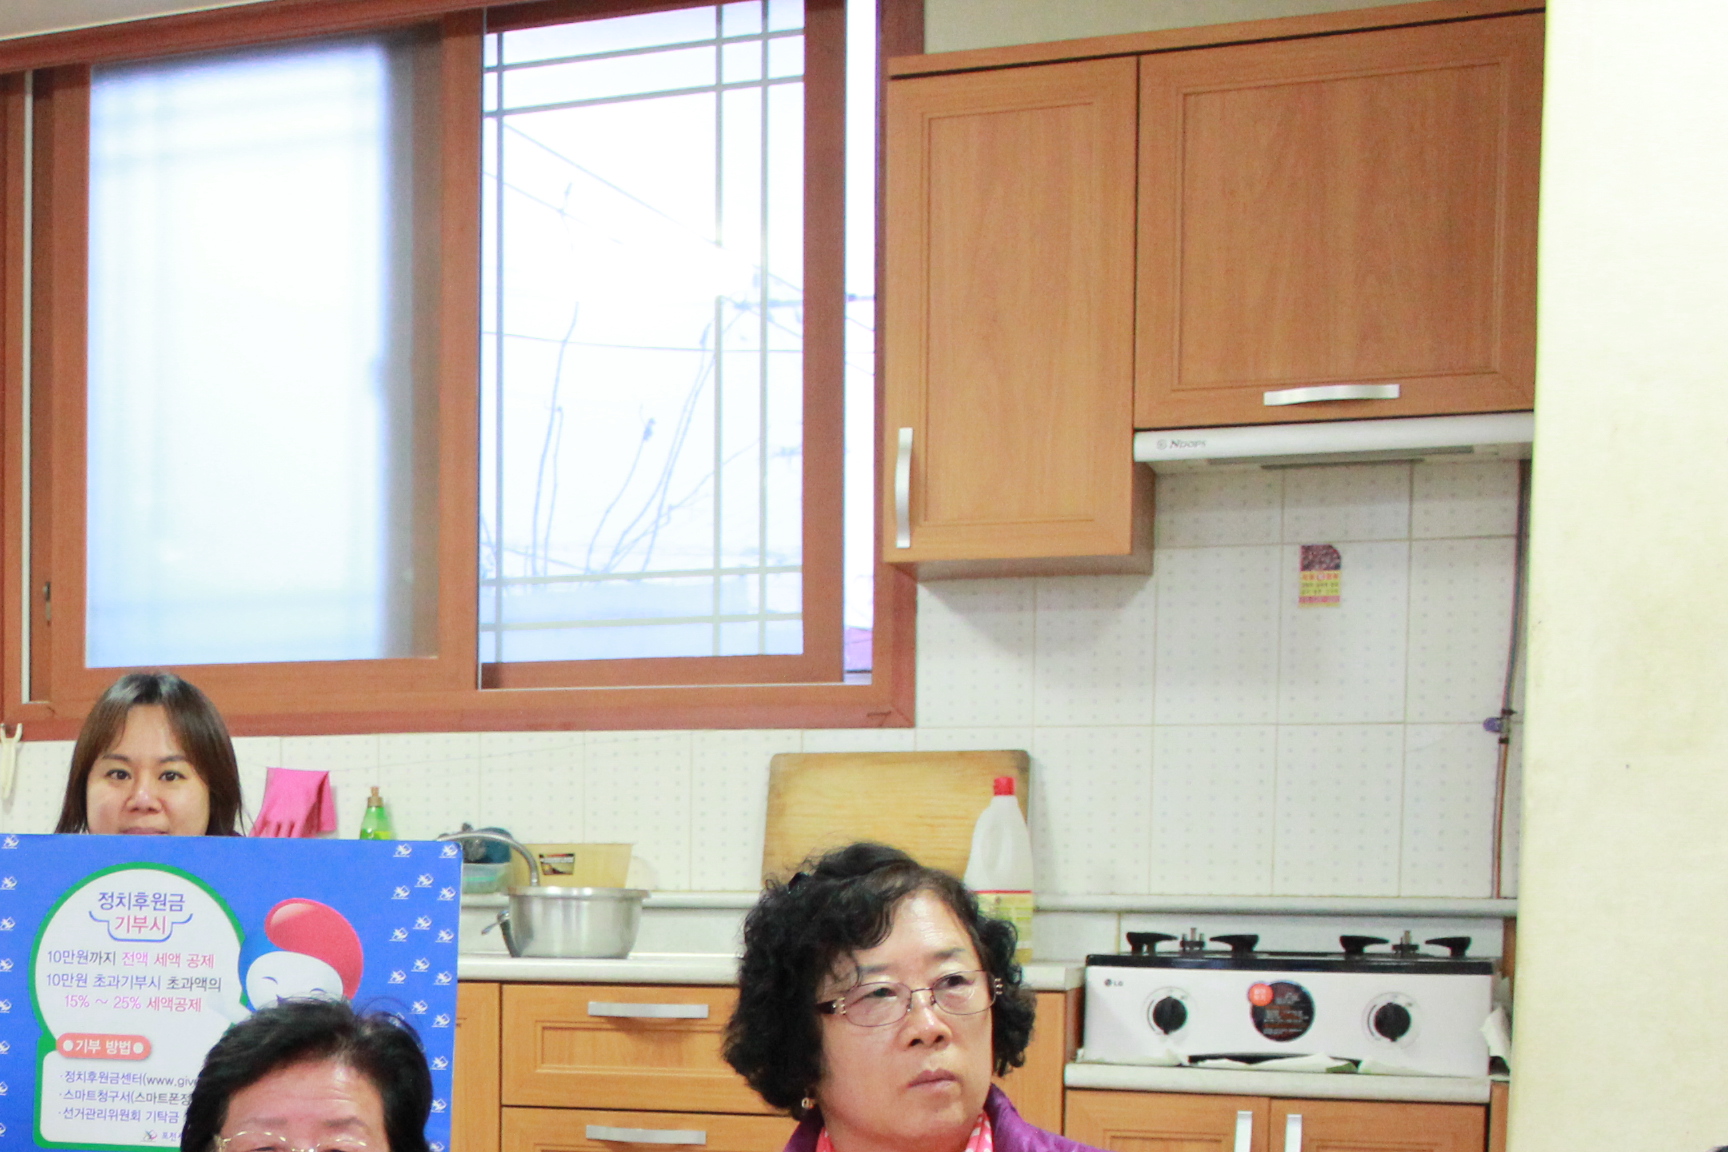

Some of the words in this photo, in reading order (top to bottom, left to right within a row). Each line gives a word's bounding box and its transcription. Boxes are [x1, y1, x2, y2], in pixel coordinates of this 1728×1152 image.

[98, 891, 186, 913] 정치후원금
[114, 915, 167, 935] 기부시
[47, 949, 116, 966] 10만원까지
[121, 951, 149, 967] 전액
[153, 952, 182, 968] 세액
[186, 953, 215, 969] 공제
[46, 972, 89, 989] 10만원
[92, 974, 162, 990] 초과기부시
[166, 976, 222, 992] 초과액의
[65, 994, 90, 1008] 15%
[113, 996, 142, 1010] 25%
[146, 997, 203, 1012] 세액공제
[75, 1039, 101, 1054] 기부
[105, 1040, 132, 1055] 방법
[62, 1106, 142, 1123] 선거관리위원회
[145, 1110, 180, 1124] 기탁금
